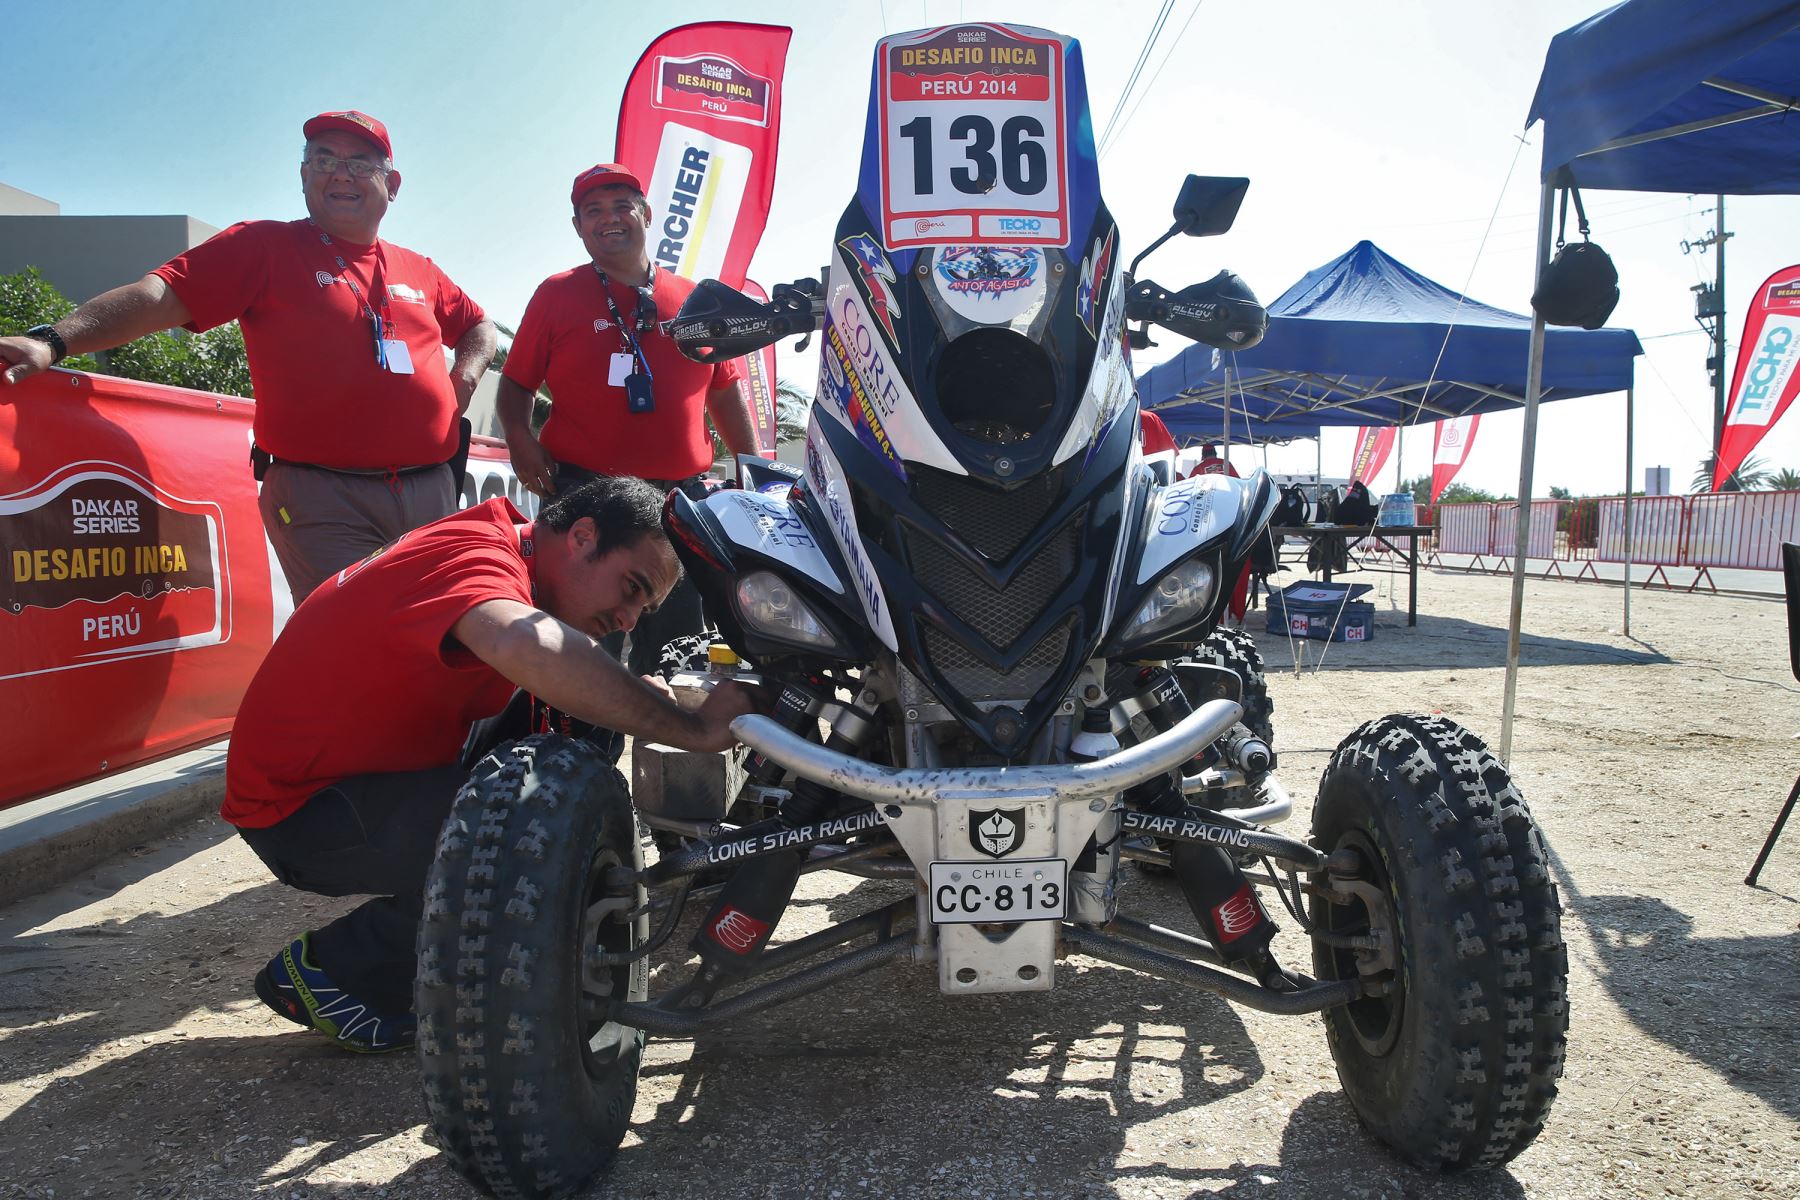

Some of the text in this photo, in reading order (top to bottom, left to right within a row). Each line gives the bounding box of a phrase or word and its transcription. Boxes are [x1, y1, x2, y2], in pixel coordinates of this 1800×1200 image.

[902, 47, 1037, 66] DESAFIO INCA
[701, 62, 732, 74] DAKAR
[701, 68, 732, 80] SERIES
[677, 73, 753, 98] DESAFIO INCA
[921, 76, 1017, 95] PERÚ 2014
[701, 100, 727, 112] PERÚ
[899, 114, 1048, 195] 136
[655, 146, 710, 274] RCHER
[998, 218, 1041, 231] TECHO
[948, 277, 1031, 293] ANTOFAGASTA
[844, 298, 900, 414] CORE
[1737, 326, 1792, 415] TECHO
[828, 324, 846, 360] LUIS
[843, 359, 885, 443] BARAHONA
[71, 498, 139, 516] DAKAR
[73, 516, 141, 535] SERIES
[12, 544, 188, 583] DESAFIO INCA
[838, 505, 880, 626] YAMAHA
[83, 606, 141, 642] PERÚ
[1292, 620, 1308, 631] CH
[1347, 629, 1362, 639] CH
[708, 811, 888, 863] LONE STAR RACING
[1123, 812, 1250, 848] STAR RACING
[972, 868, 1023, 880] CHILE
[283, 946, 310, 997] ALOMON
